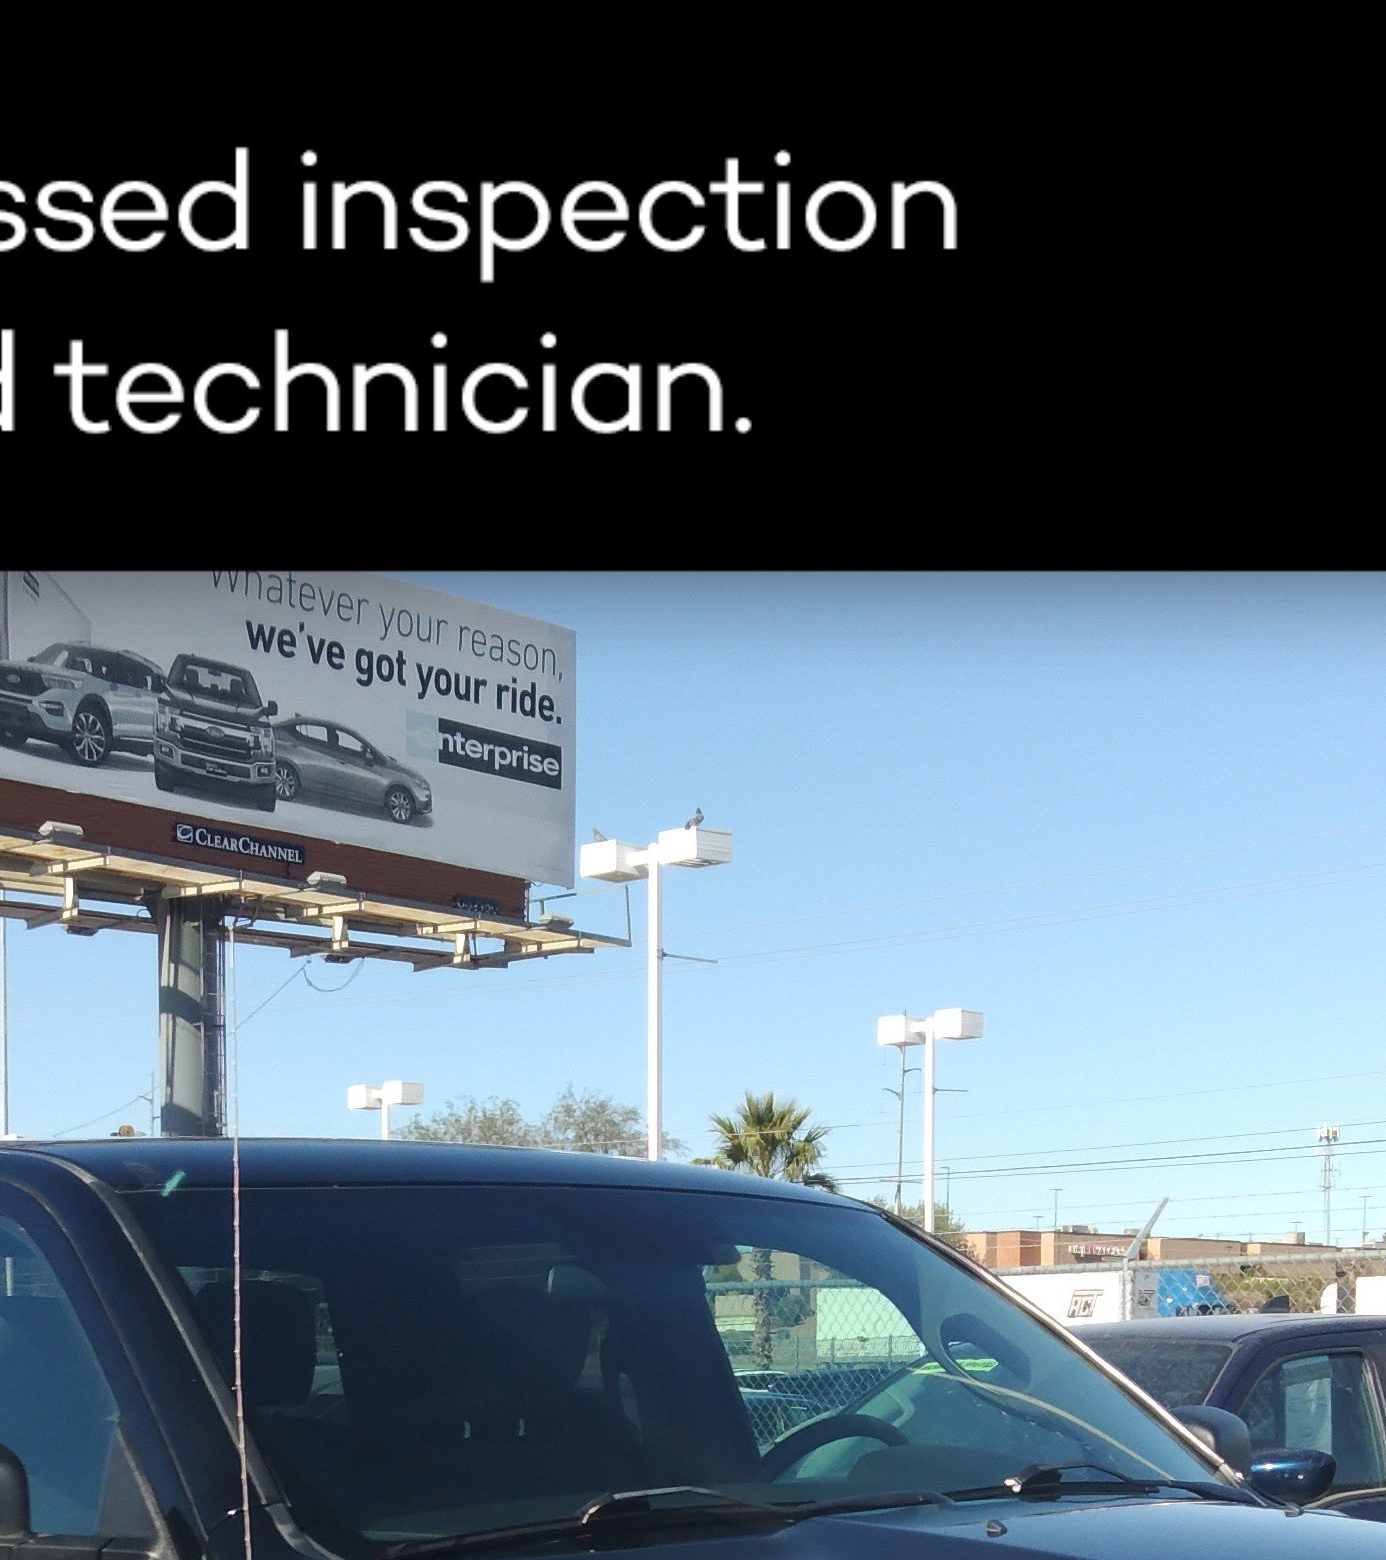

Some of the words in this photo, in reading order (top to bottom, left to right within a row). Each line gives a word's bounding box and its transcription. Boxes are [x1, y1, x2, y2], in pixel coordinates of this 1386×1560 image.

[245, 619, 346, 670] we've
[355, 647, 407, 687] got
[415, 661, 487, 705] your
[496, 676, 562, 724] ride.
[379, 603, 448, 646] your
[458, 624, 563, 683] reason,
[410, 727, 560, 776] nterprise
